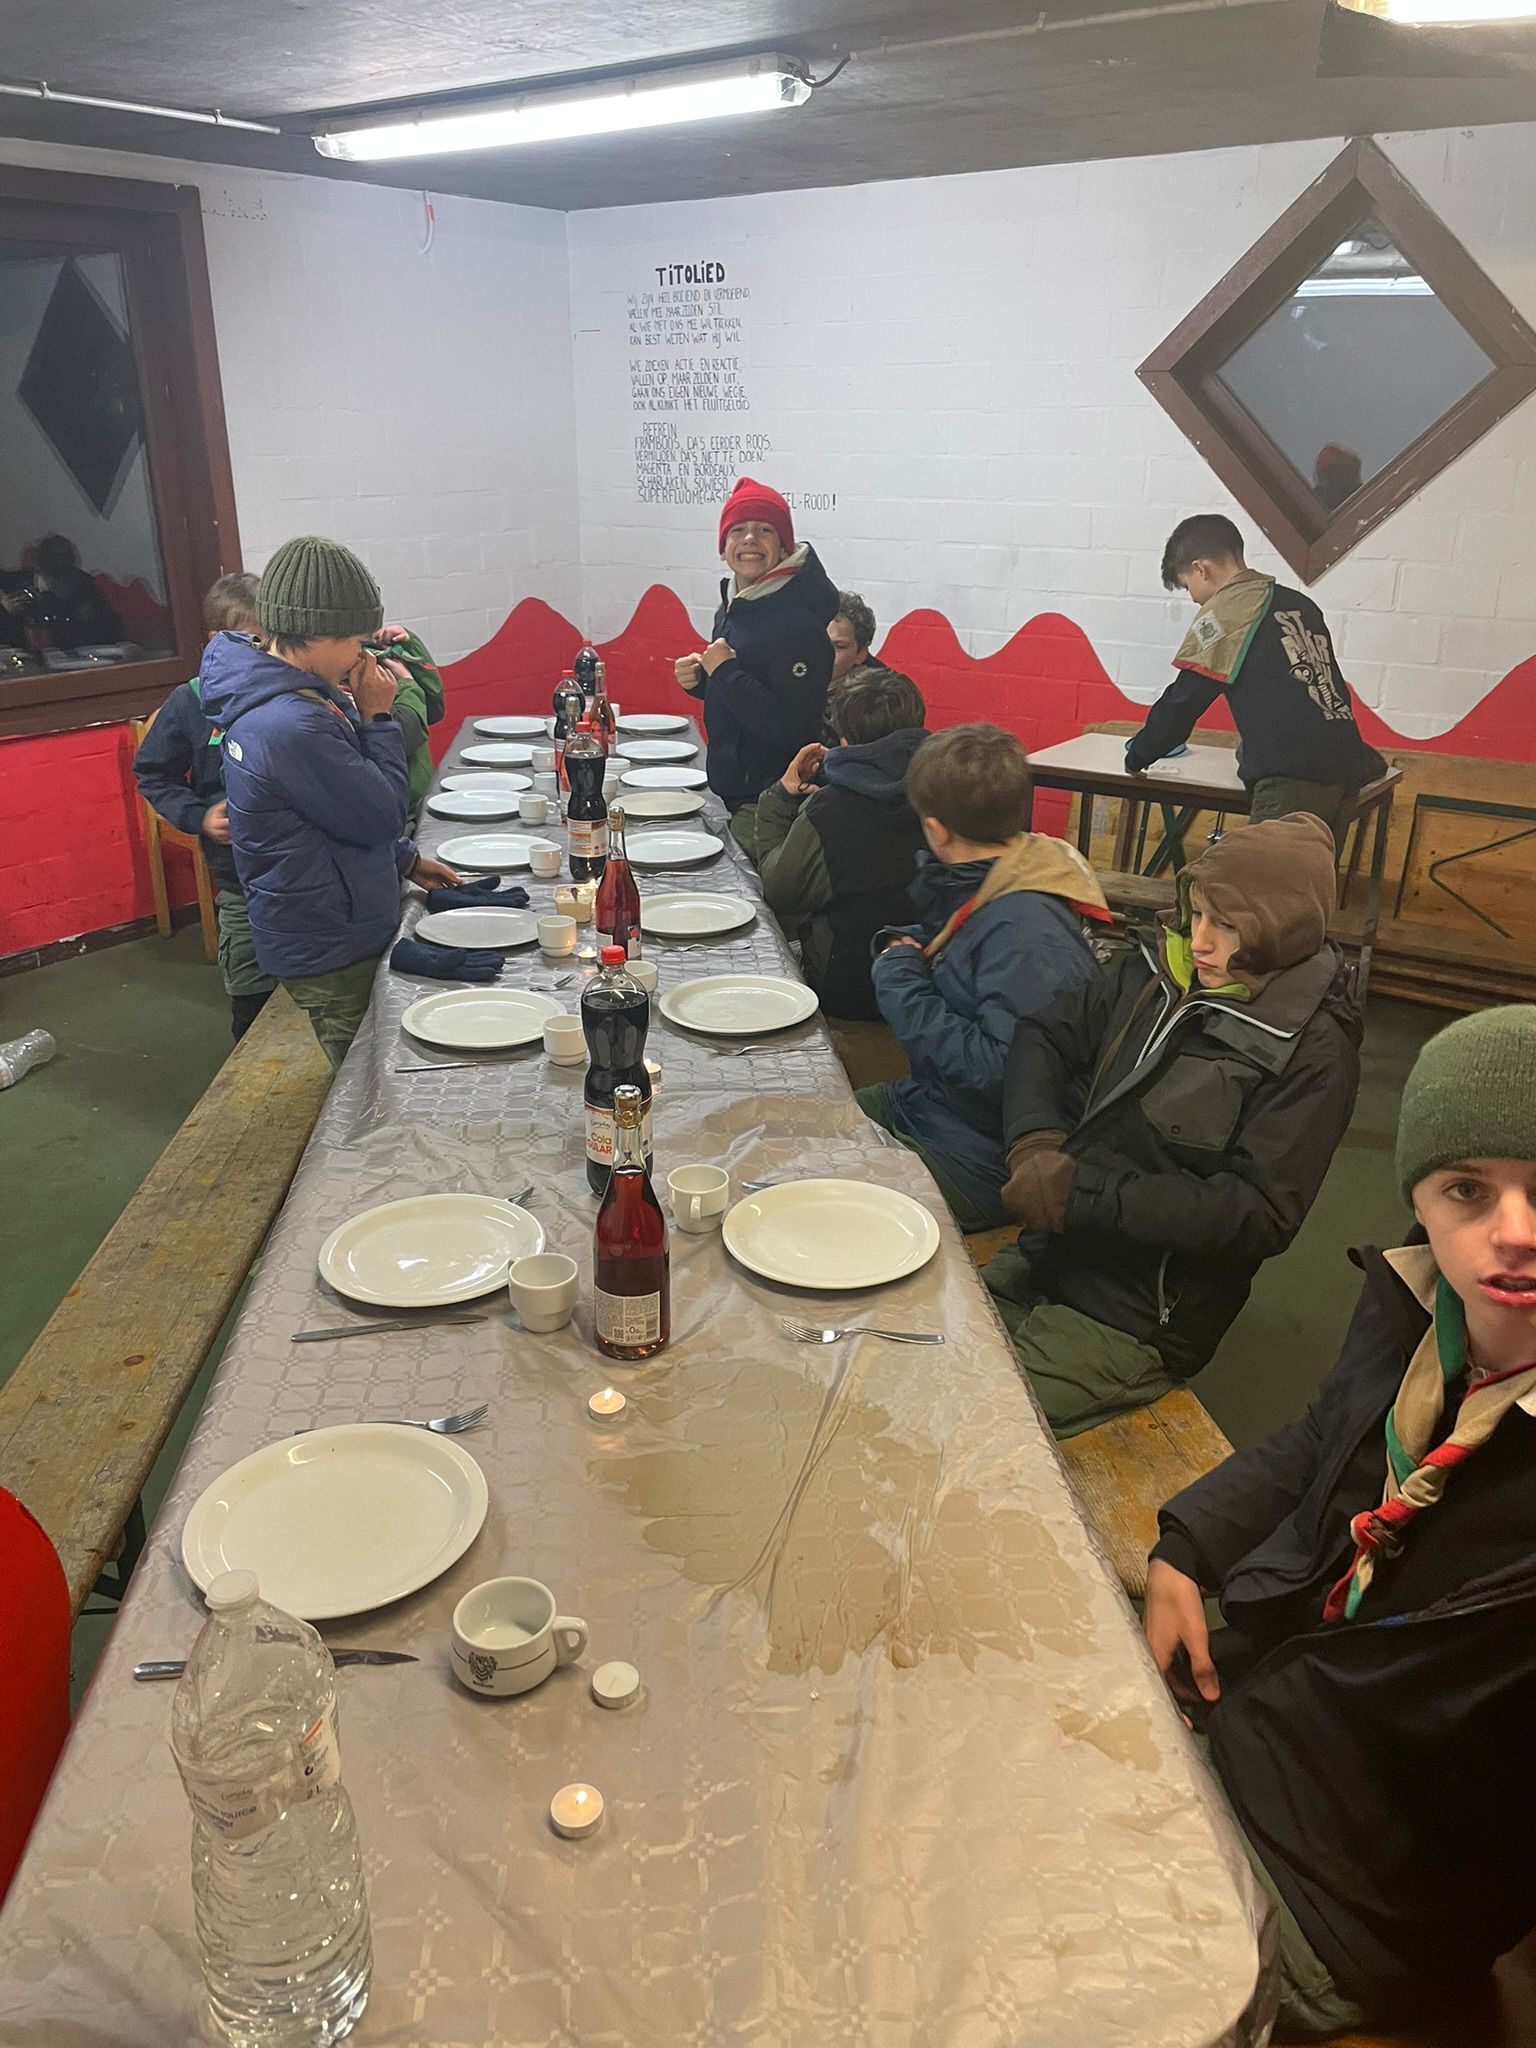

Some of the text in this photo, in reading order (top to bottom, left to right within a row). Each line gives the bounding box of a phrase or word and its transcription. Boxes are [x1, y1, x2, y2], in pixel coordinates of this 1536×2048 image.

[645, 333, 662, 346] BEST
[664, 332, 689, 345] WETEN
[690, 332, 708, 344] WAT
[629, 359, 641, 372] WE
[674, 358, 694, 371] ACTIE
[700, 357, 711, 371] EN
[630, 373, 655, 387] VALLEN
[671, 371, 692, 385] MAAR
[693, 371, 719, 385] ZELDEN
[631, 386, 649, 399] GAAN
[651, 386, 666, 399] ONS
[669, 385, 689, 399] EIGEN
[633, 400, 646, 411] OOK
[683, 398, 698, 412] HET
[711, 435, 741, 451] EERDER
[723, 450, 734, 464] TE
[636, 462, 672, 476] MAGENTA
[678, 462, 690, 476] EN
[637, 475, 687, 490] SCHARLAKEN
[781, 492, 837, 511] EL-ROOD!
[591, 1132, 612, 1145] Cola
